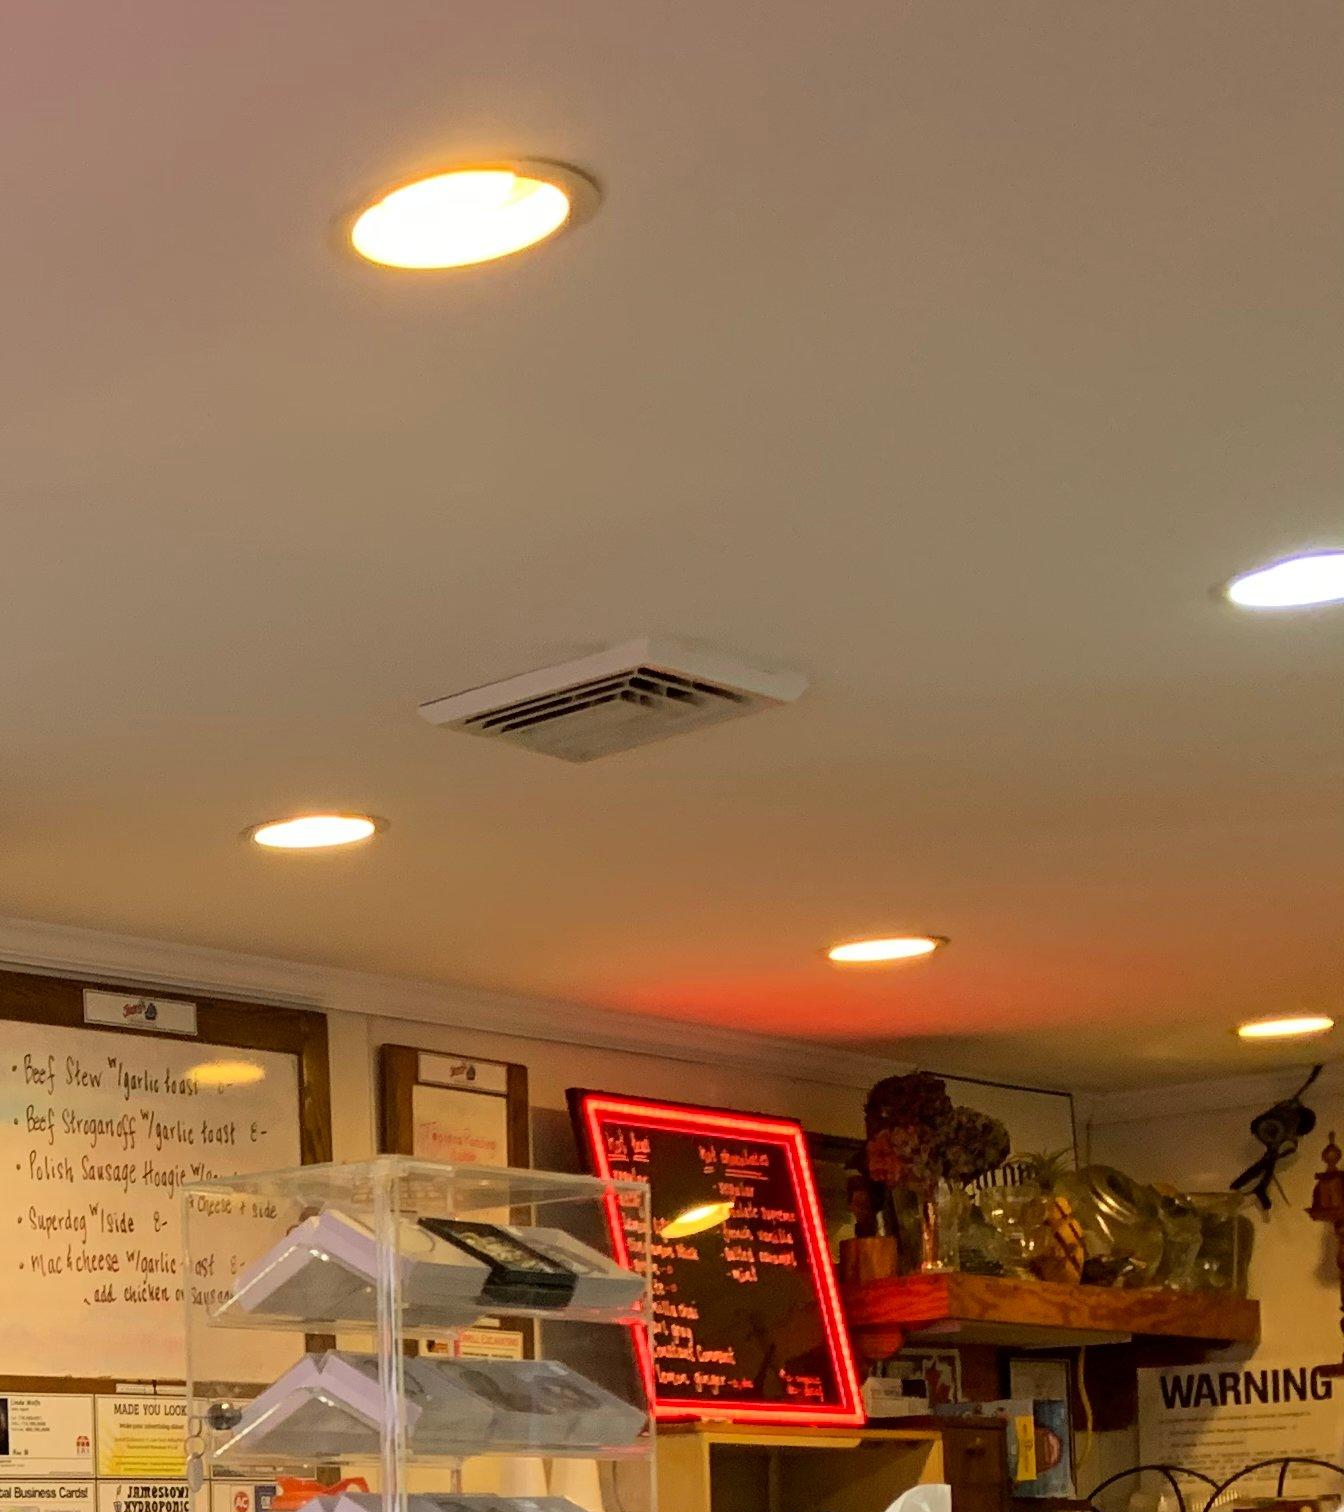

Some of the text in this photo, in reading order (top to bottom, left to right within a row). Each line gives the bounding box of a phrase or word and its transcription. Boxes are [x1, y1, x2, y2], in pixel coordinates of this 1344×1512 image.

[23, 1053, 56, 1096] Beef
[65, 1055, 103, 1089] Stew
[26, 1104, 56, 1145] Beef
[62, 1108, 136, 1151] Stroganoff
[201, 1120, 237, 1145] toast
[29, 1150, 74, 1183] Polish
[81, 1155, 137, 1193] Sausage
[142, 1160, 186, 1200] Hoagie
[28, 1206, 87, 1244] Superdog
[94, 1284, 116, 1304] add
[1159, 1364, 1335, 1411] WARNING
[114, 1403, 140, 1415] MADE
[142, 1404, 162, 1416] YOU
[14, 1486, 57, 1499] Business
[59, 1486, 89, 1499] Cards!
